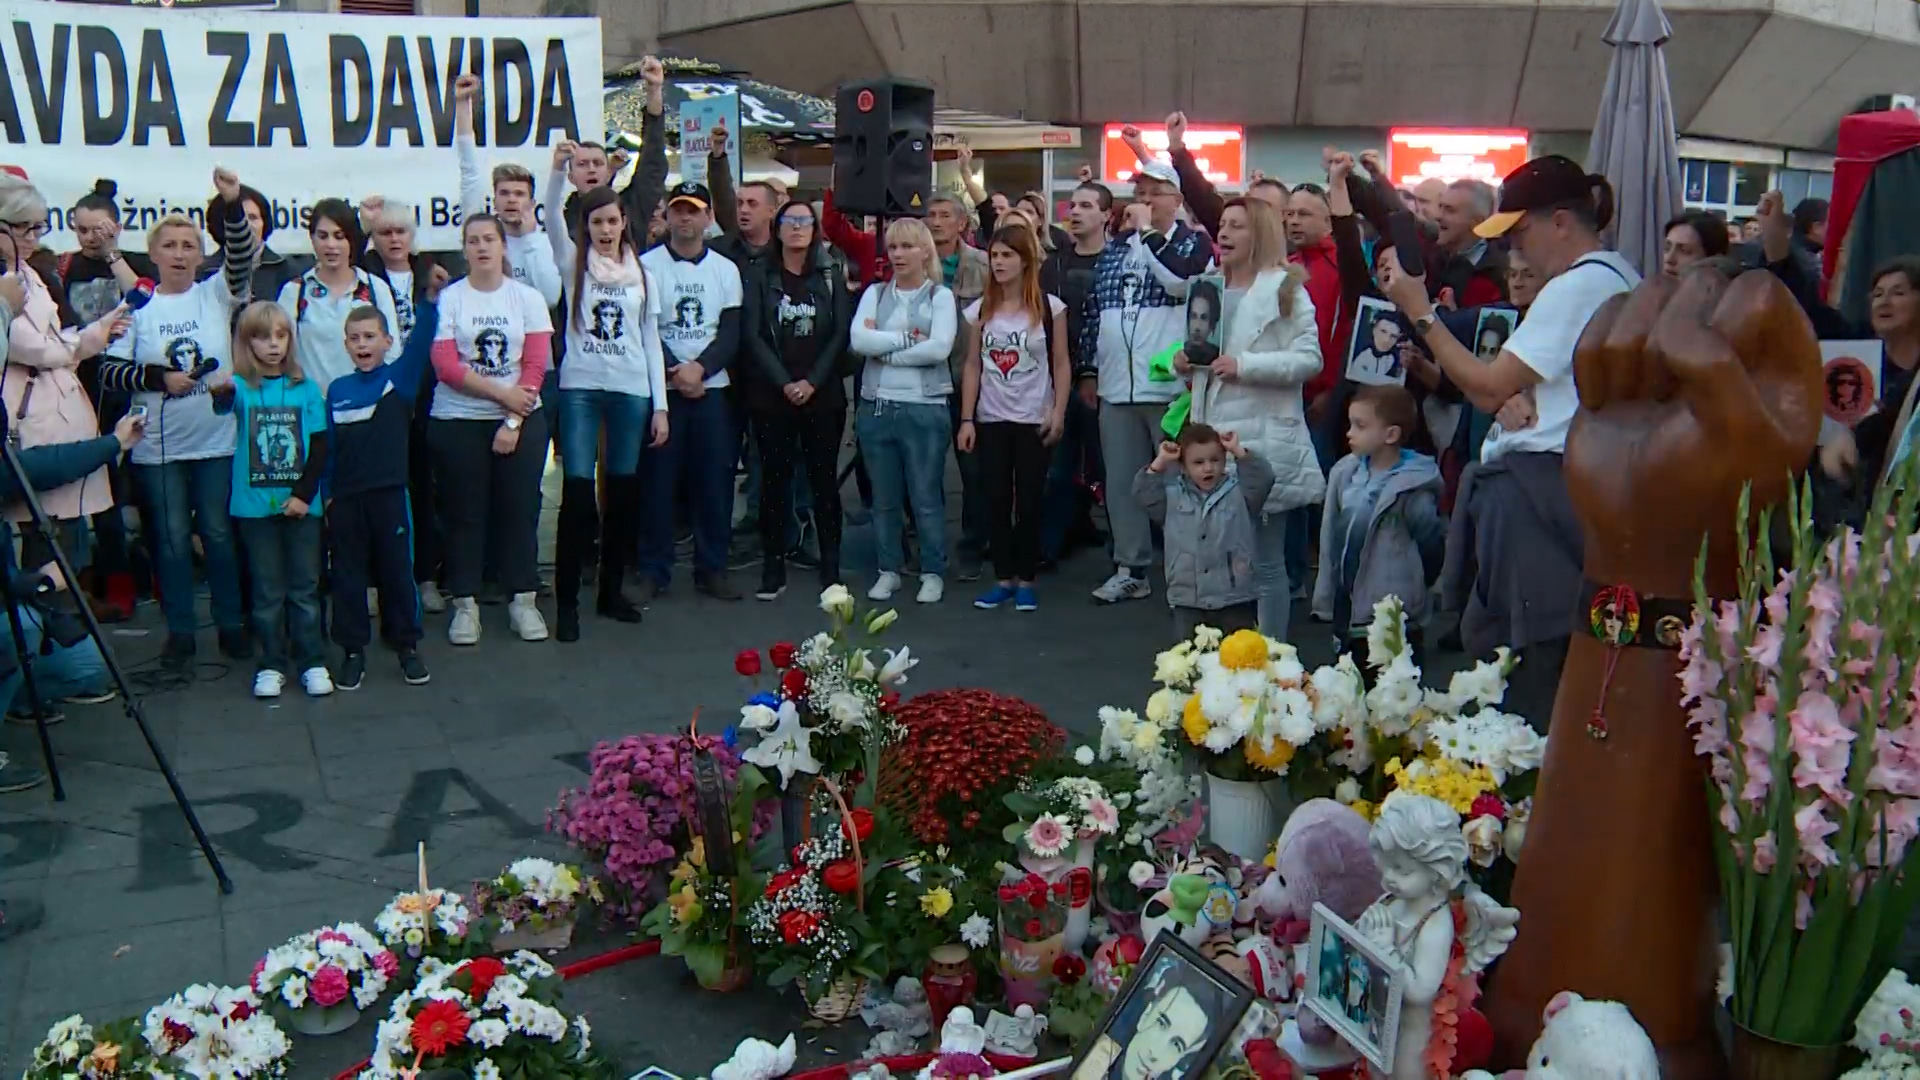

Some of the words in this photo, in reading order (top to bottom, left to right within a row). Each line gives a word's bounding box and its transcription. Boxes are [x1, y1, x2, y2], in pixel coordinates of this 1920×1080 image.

[206, 31, 308, 148] ZA
[329, 33, 582, 149] DAVIDA
[159, 319, 200, 336] PRAVDA
[472, 315, 509, 326] PRAVDA
[582, 341, 594, 354] ZA
